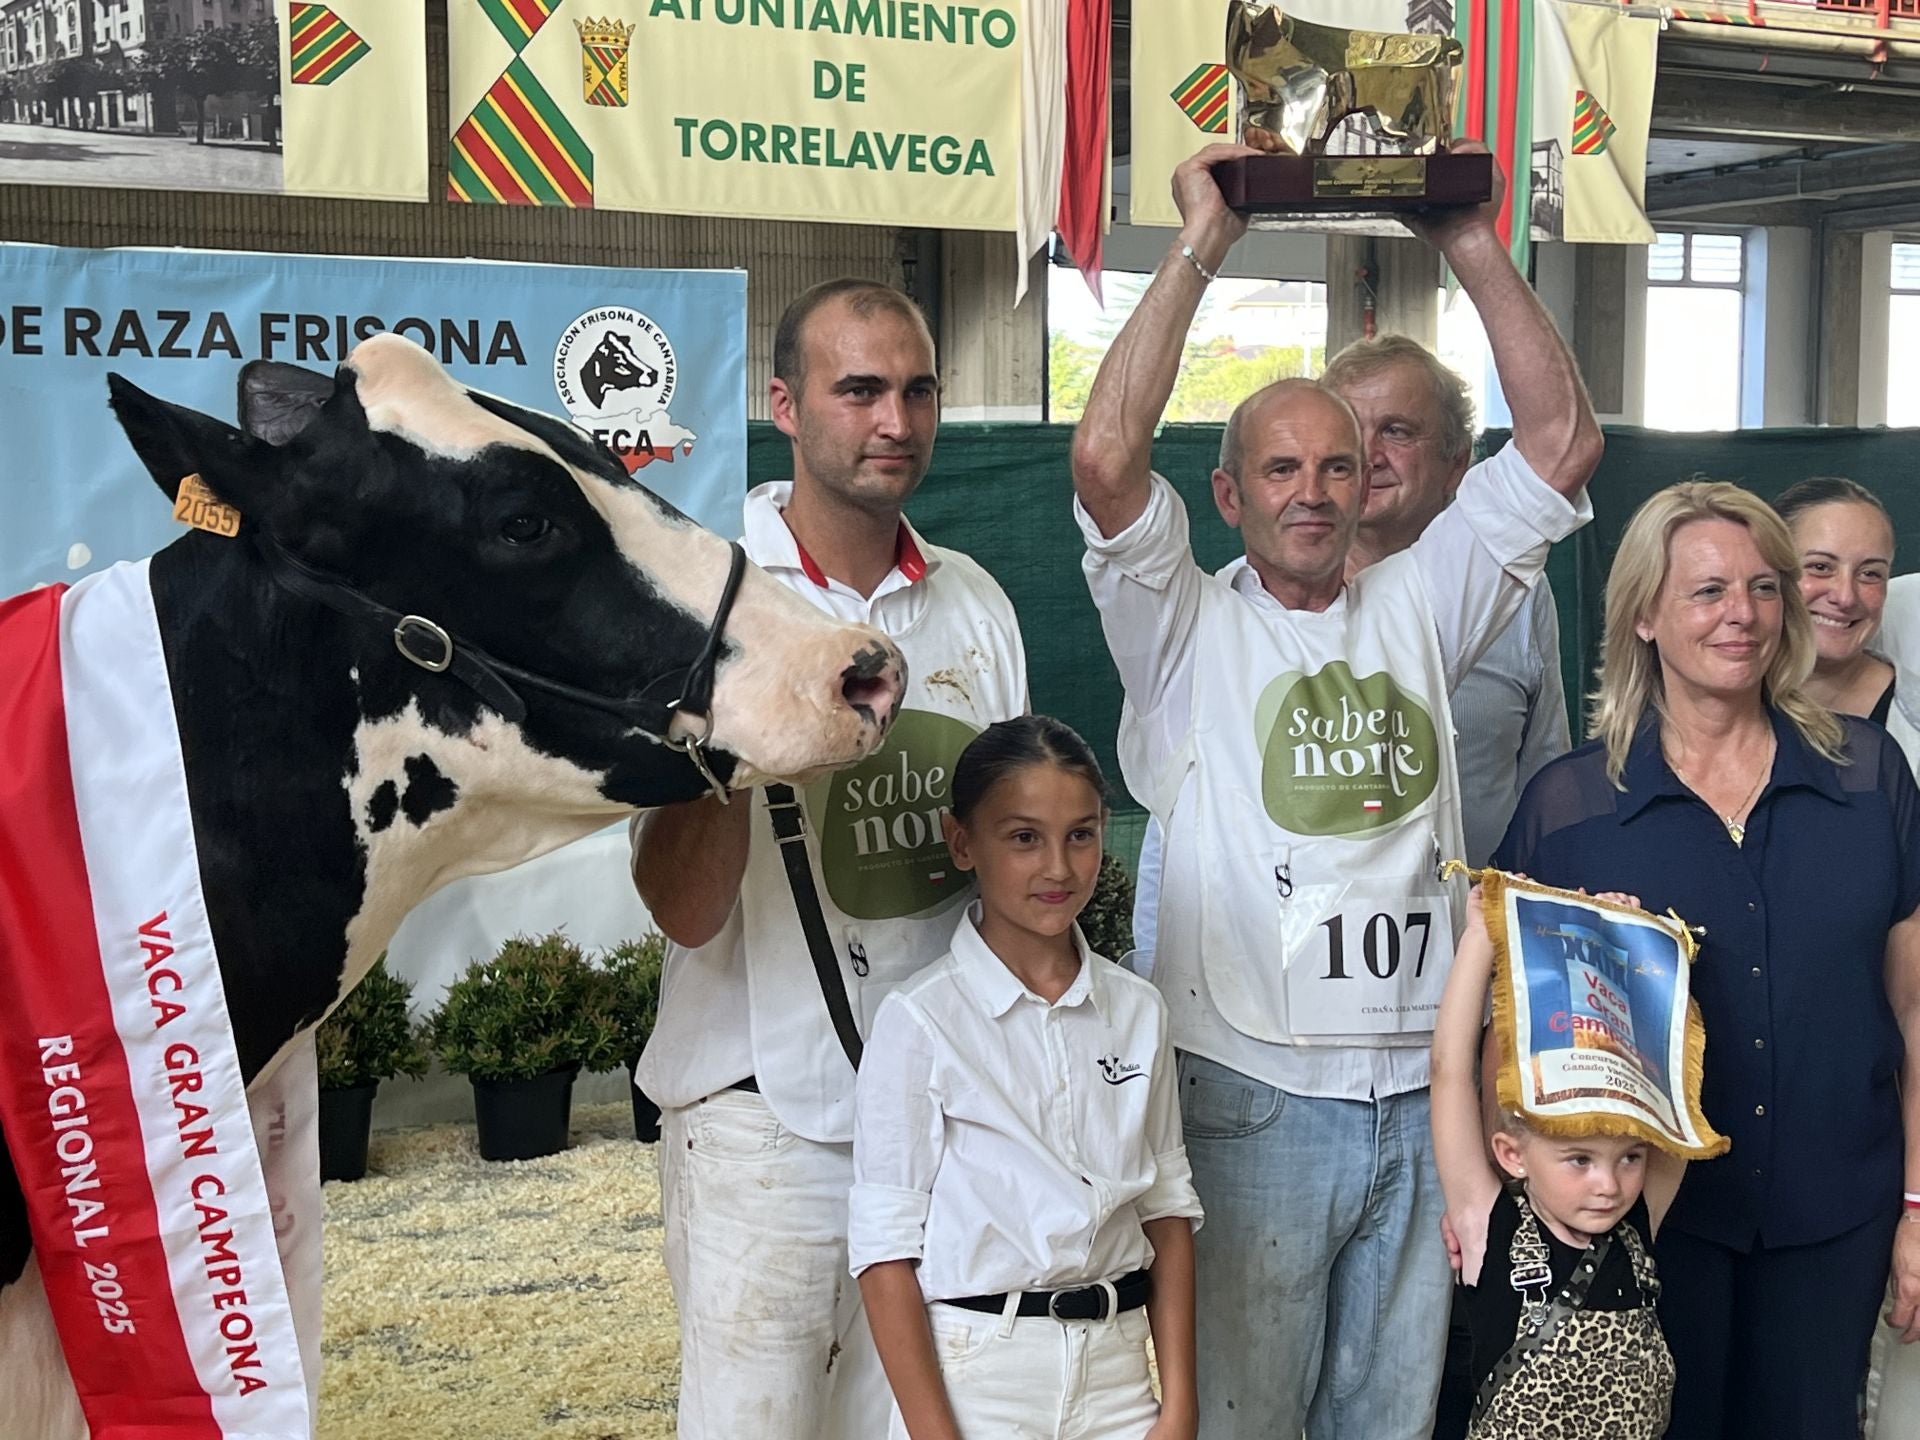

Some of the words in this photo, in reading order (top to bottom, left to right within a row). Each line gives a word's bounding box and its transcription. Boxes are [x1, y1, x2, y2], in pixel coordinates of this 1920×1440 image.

[813, 60, 866, 102] DE
[674, 117, 996, 176] TORRELAVEGA
[0, 305, 43, 355] E
[64, 307, 243, 358] RAZA
[556, 327, 581, 405] ASOCIACIÓN
[580, 310, 634, 329] FRISONA
[637, 318, 653, 334] DE
[653, 333, 675, 405] CANTABRIA
[177, 495, 234, 533] 2055
[843, 750, 947, 812] sabe
[1289, 736, 1423, 797] norte
[848, 804, 952, 856] nor
[1317, 912, 1432, 980] 107
[1584, 970, 1628, 1014] Vaca
[1605, 1075, 1637, 1095] 2025
[138, 910, 187, 1030] VACA
[164, 1042, 218, 1159] GRAN
[191, 1173, 267, 1397] CAMPEONA
[38, 1033, 108, 1248] REGIONAL
[83, 1260, 136, 1336] 2025
